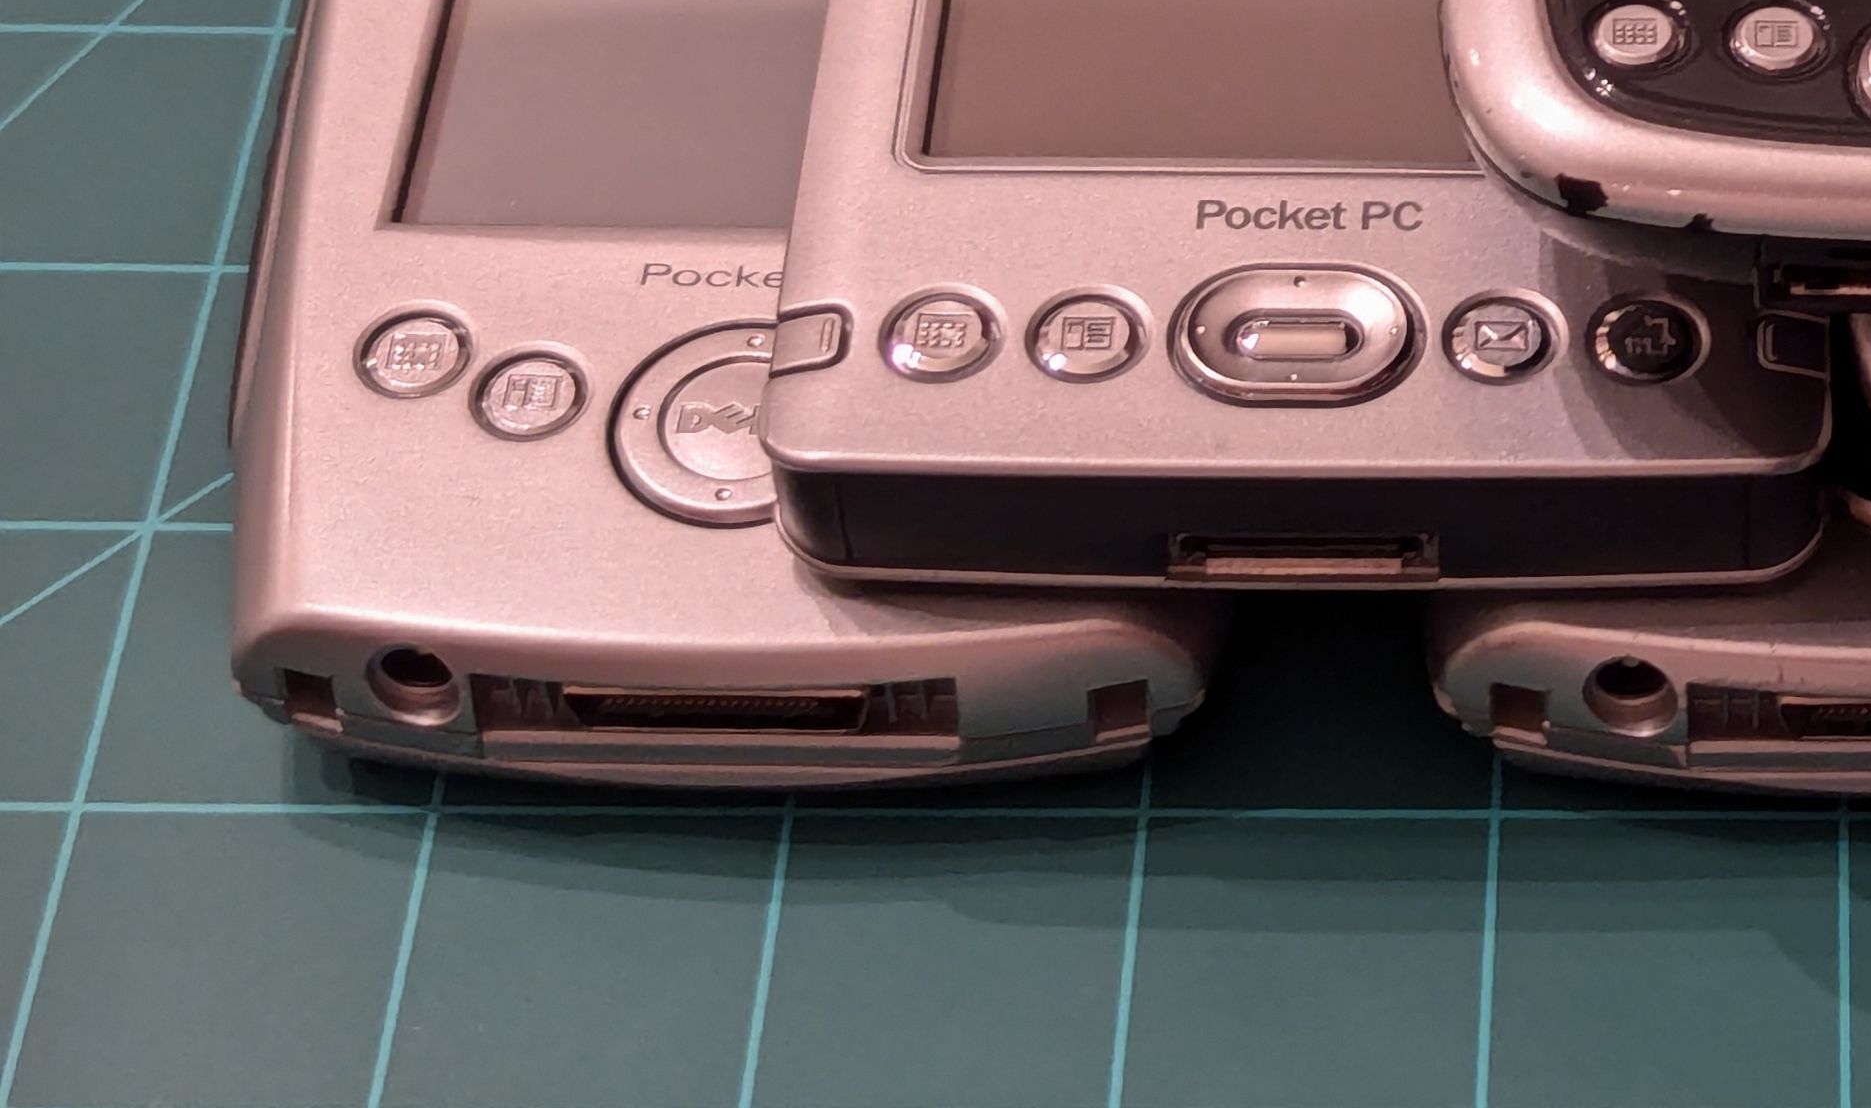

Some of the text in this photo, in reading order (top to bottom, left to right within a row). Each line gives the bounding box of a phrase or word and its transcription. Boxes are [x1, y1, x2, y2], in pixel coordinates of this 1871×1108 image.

[1195, 199, 1424, 232] Pocket PC
[639, 262, 785, 288] Pocke
[676, 401, 760, 435] DE
